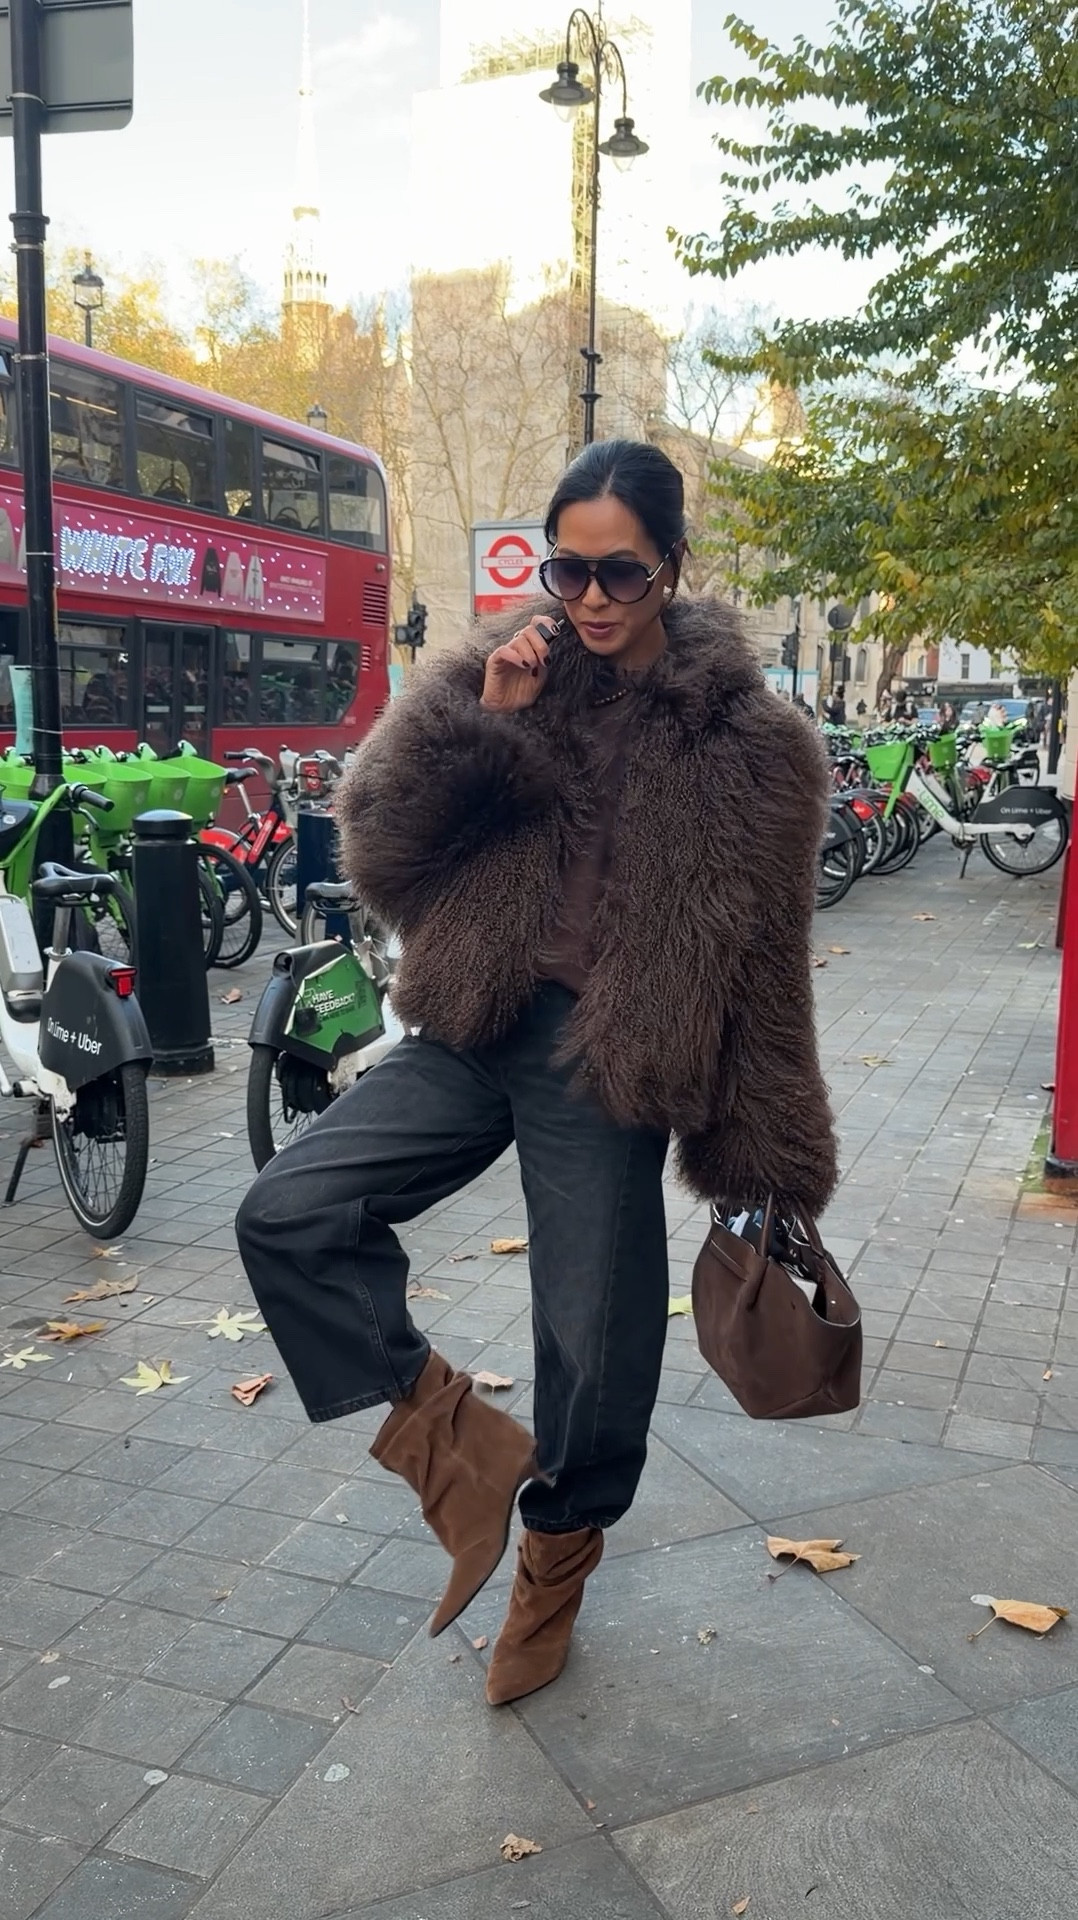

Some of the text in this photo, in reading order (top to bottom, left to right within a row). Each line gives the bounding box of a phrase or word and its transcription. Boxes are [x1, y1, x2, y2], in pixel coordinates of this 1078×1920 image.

[60, 526, 195, 585] WHITE FOX
[920, 790, 944, 819] Lime
[1000, 807, 1010, 815] On
[1011, 807, 1029, 815] Lime
[312, 990, 334, 1003] HAVE
[53, 1021, 69, 1042] Lime
[78, 1032, 102, 1055] Uber
